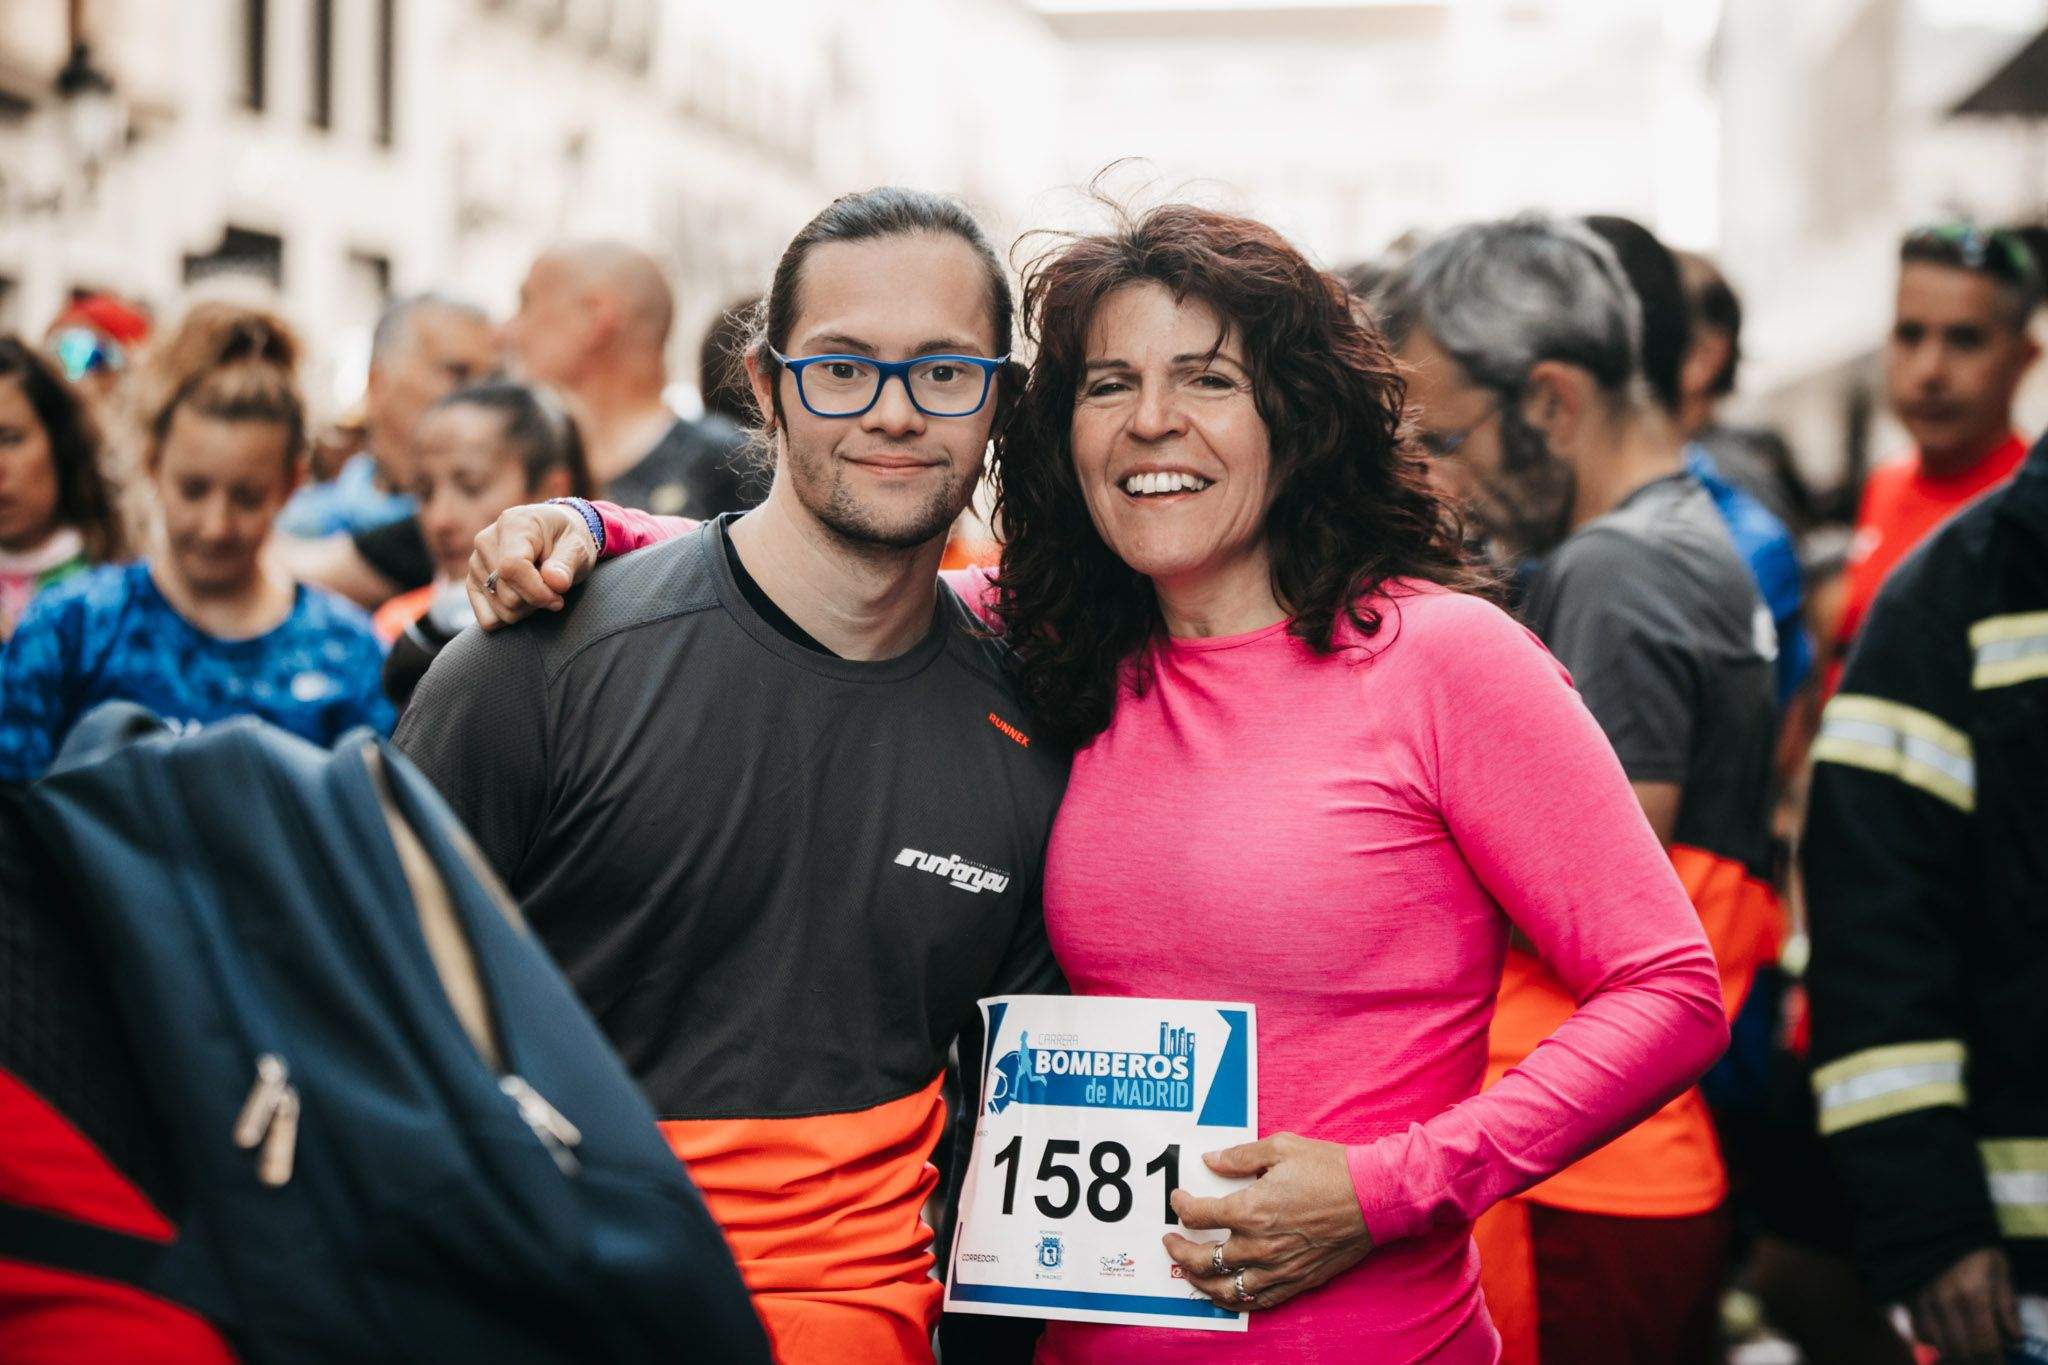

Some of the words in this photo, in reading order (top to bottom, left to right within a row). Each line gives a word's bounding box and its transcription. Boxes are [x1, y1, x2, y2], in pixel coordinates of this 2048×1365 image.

[988, 712, 1031, 748] RUNNEK
[1035, 1050, 1189, 1081] BOMBEROS
[1085, 1078, 1107, 1104] de
[1112, 1078, 1189, 1108] MADRID
[994, 1135, 1181, 1225] 1581
